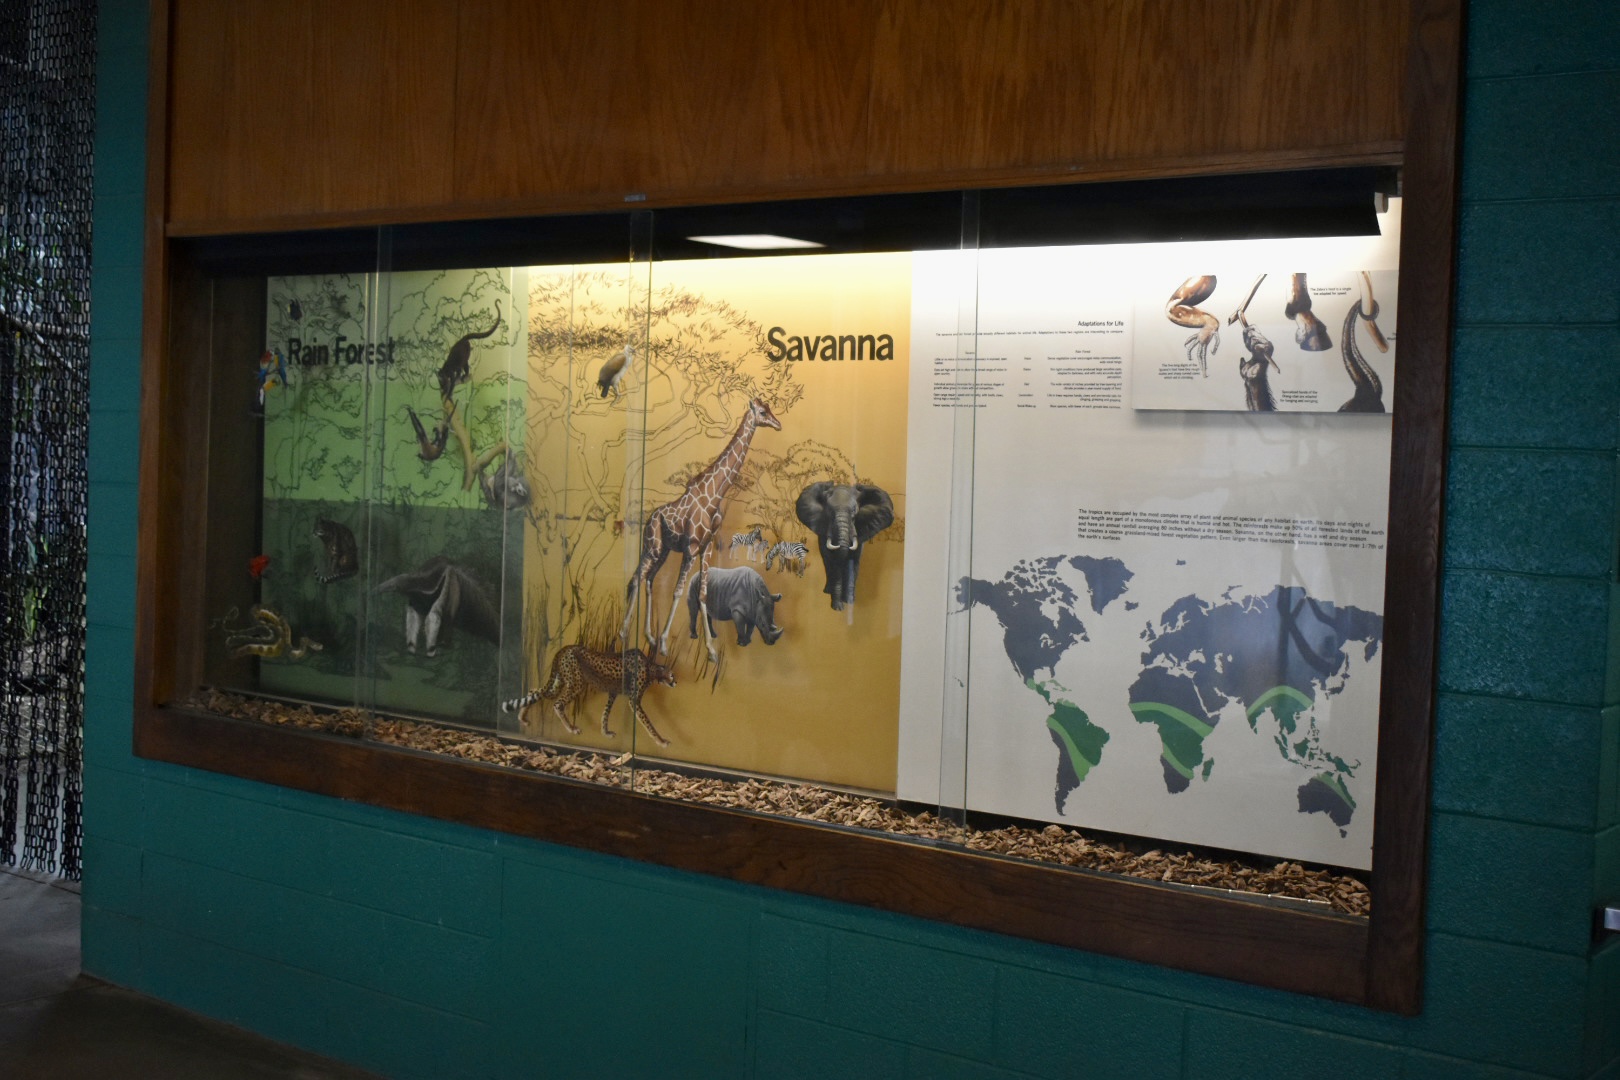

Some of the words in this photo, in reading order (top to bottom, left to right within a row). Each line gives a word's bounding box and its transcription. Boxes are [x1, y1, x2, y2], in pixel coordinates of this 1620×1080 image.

[288, 337, 329, 365] Rain
[335, 336, 395, 364] Forest
[767, 326, 894, 362] Savanna
